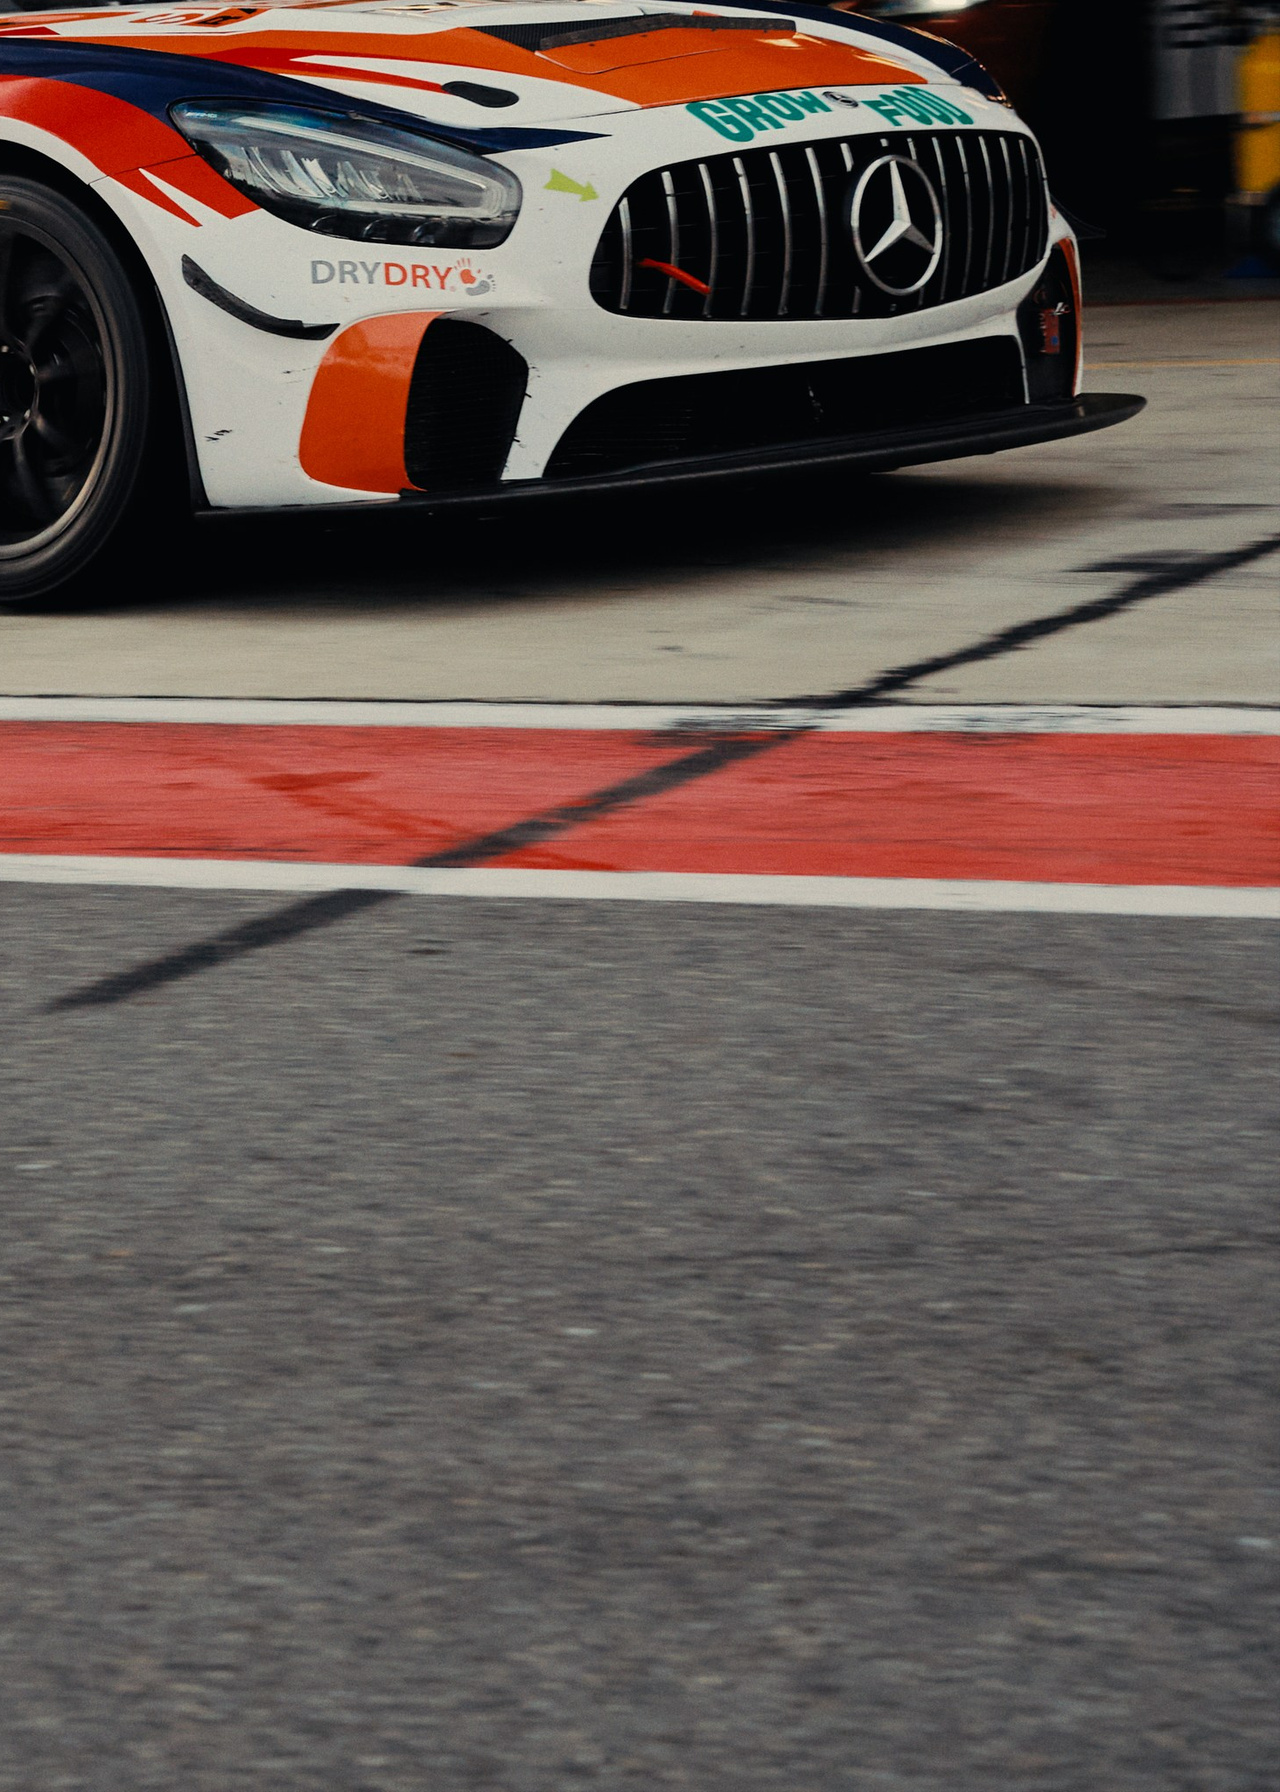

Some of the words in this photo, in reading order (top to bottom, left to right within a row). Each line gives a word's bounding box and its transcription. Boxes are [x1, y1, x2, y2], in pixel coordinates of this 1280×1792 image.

[686, 90, 832, 142] GROW
[861, 86, 974, 126] FOOD
[311, 260, 453, 290] DRYDRY
